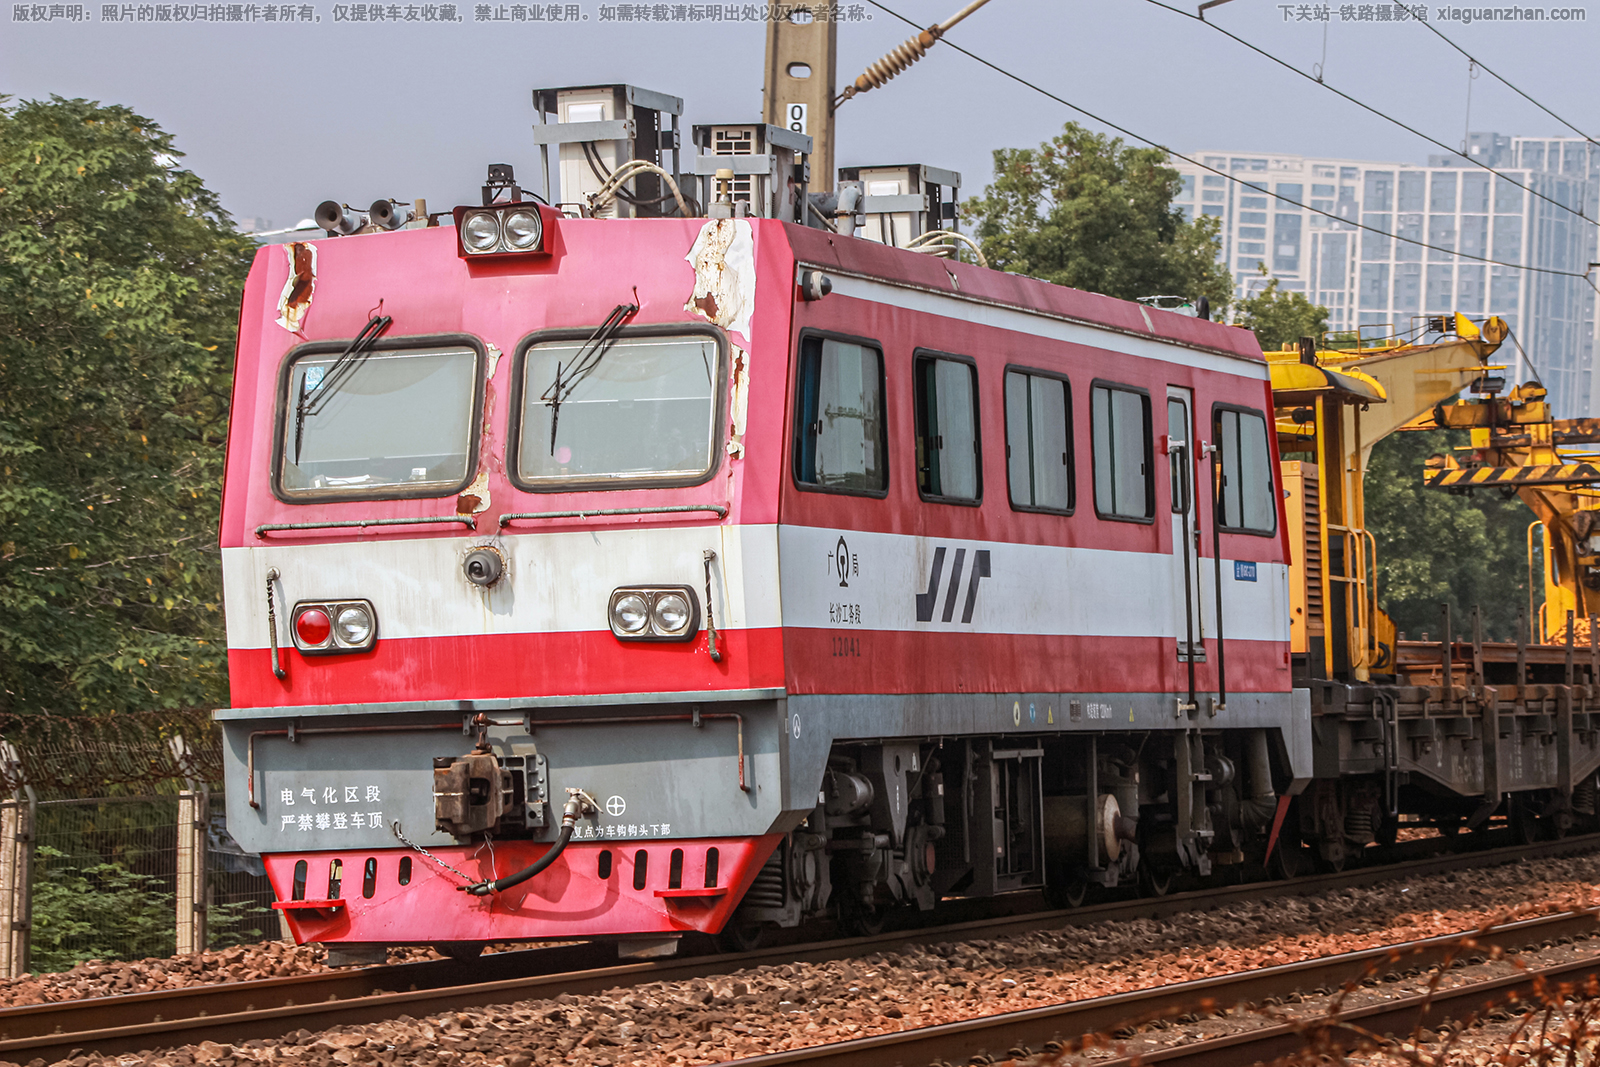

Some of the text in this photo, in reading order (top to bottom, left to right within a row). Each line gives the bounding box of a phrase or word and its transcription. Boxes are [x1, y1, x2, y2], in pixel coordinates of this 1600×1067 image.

[790, 105, 803, 153] 09
[827, 551, 834, 575] 广
[829, 602, 862, 624] 长沙工务段
[832, 637, 861, 657] 12041
[280, 785, 381, 806] 电气化区段
[280, 811, 383, 832] 严禁攀登车顶
[571, 823, 671, 838] 复点为车钩钩头下部
